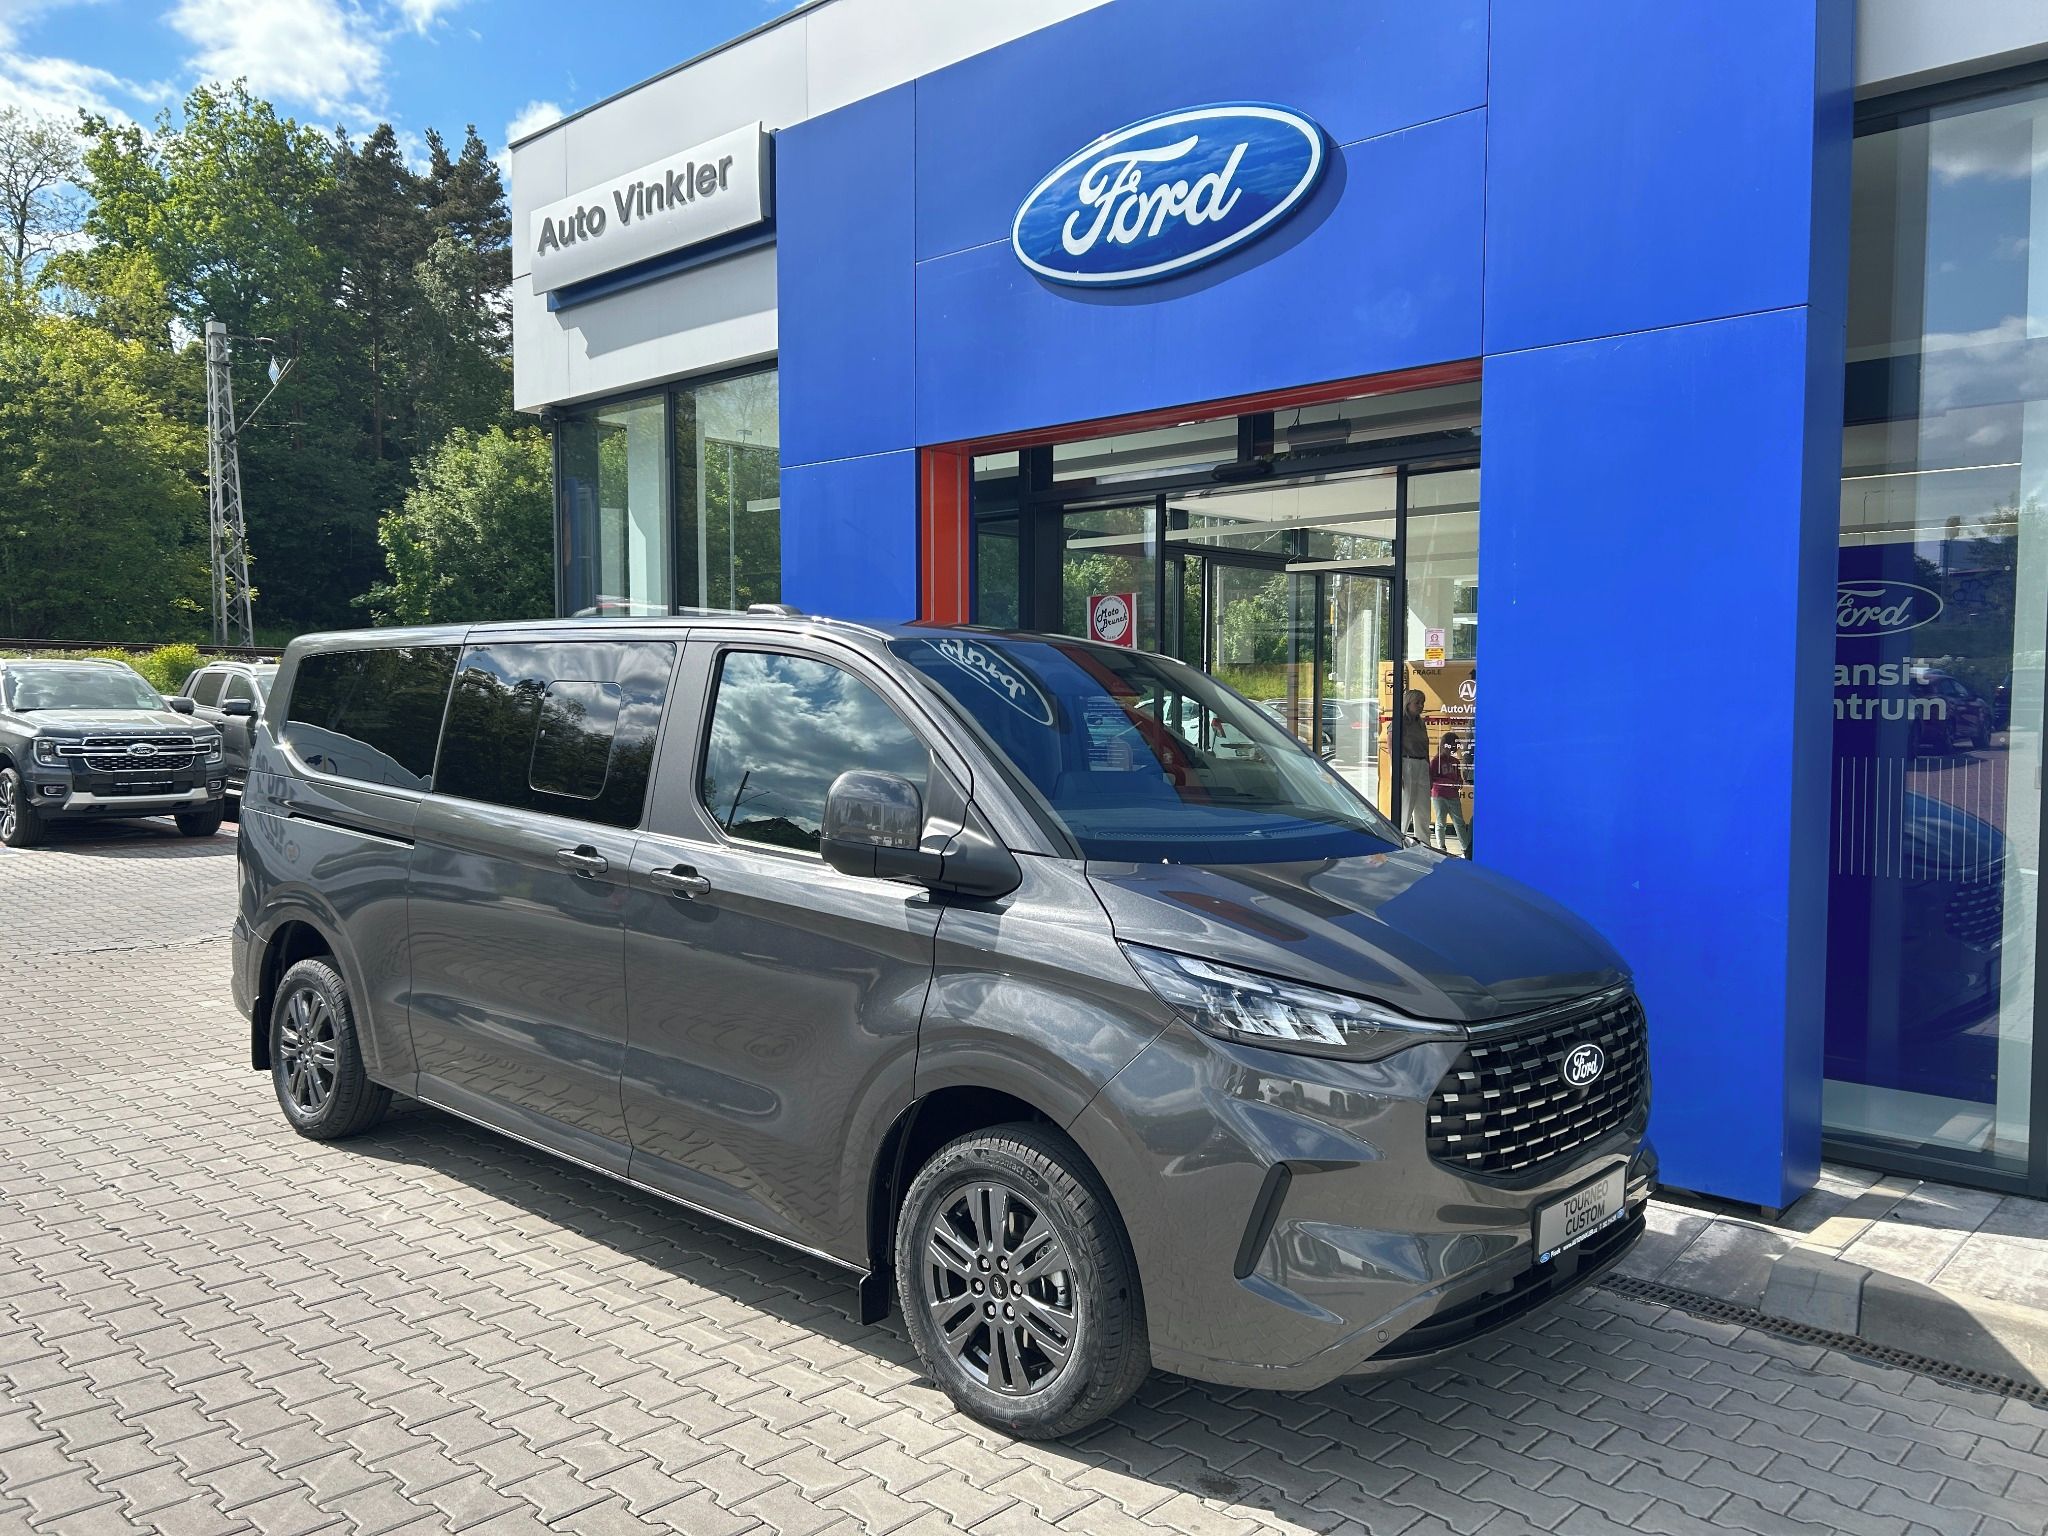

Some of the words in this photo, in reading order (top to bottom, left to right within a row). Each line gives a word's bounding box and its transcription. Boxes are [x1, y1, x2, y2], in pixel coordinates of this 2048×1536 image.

[537, 205, 606, 256] Auto
[613, 155, 733, 225] Vinkler
[1062, 134, 1249, 256] Ford
[1097, 608, 1120, 623] Moto
[1100, 612, 1128, 632] Brunch
[1833, 657, 1930, 686] ansit
[1572, 1050, 1599, 1081] Ford
[1563, 1180, 1609, 1218] TOURNEO
[1565, 1200, 1606, 1236] CUSTOM
